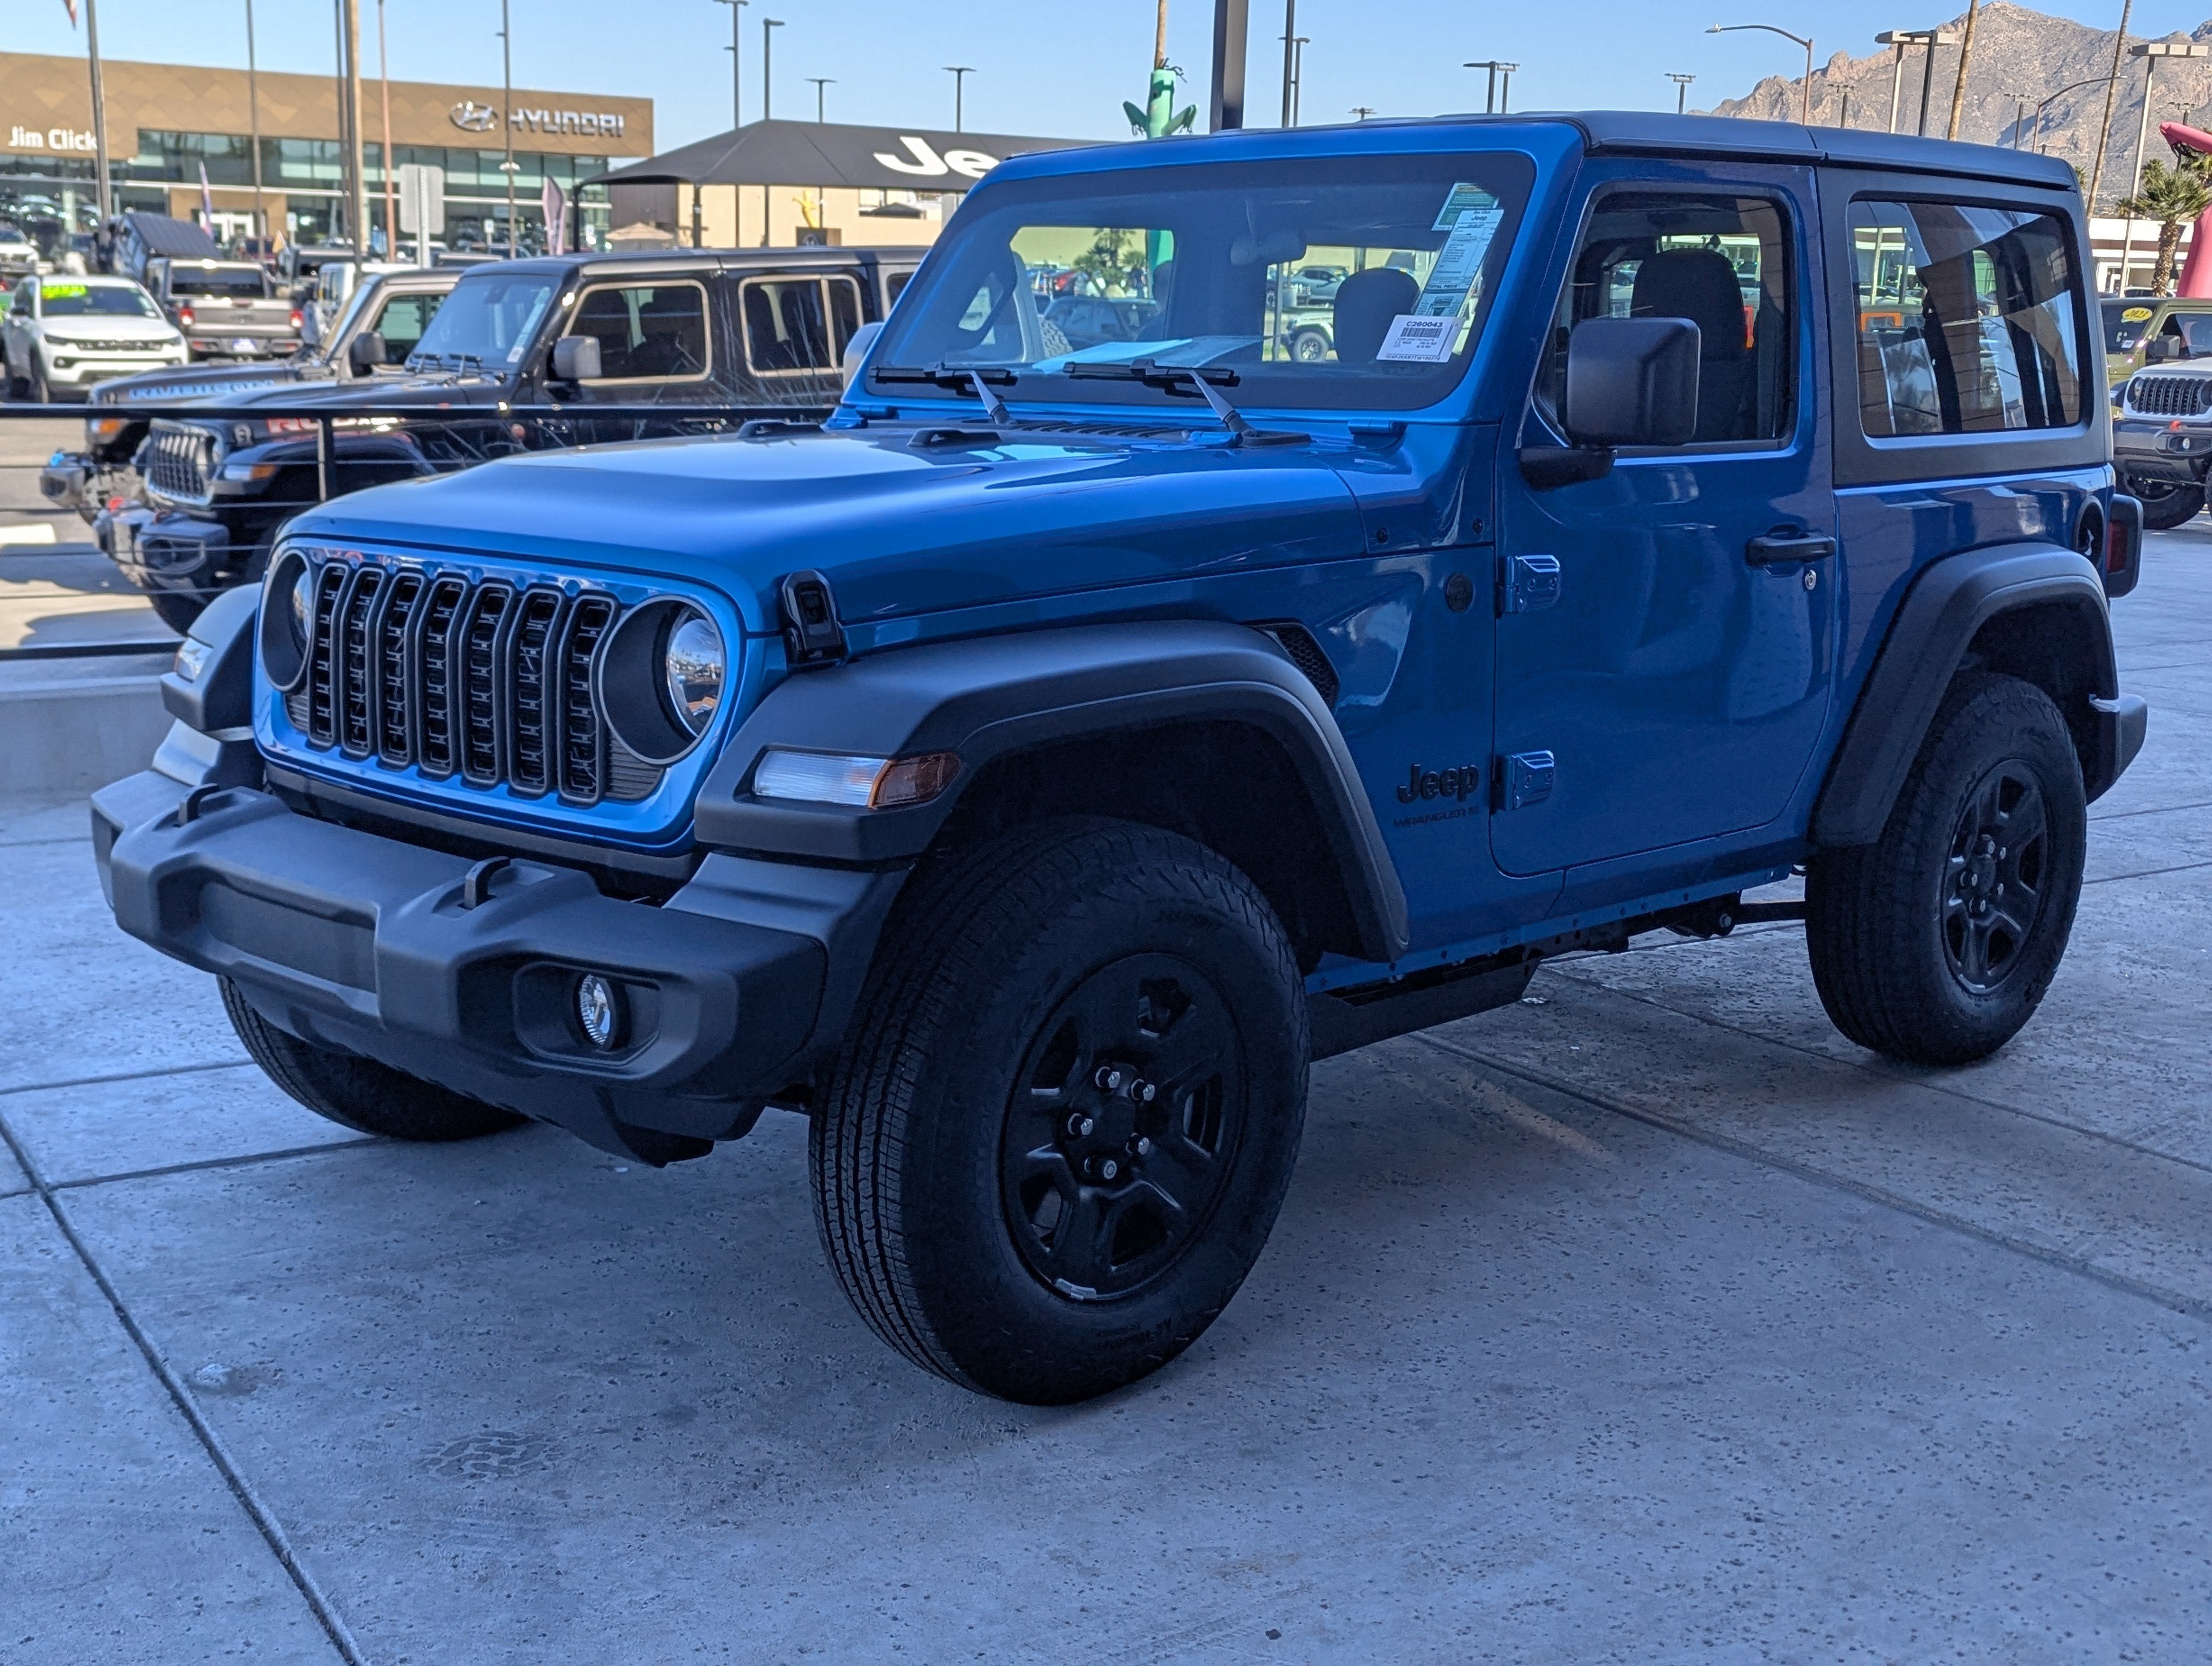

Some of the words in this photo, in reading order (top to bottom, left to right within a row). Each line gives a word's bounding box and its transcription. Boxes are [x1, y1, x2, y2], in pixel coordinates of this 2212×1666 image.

[510, 107, 625, 138] HYUNDAI
[8, 126, 44, 148] Jim
[48, 129, 98, 151] Click
[2125, 309, 2149, 318] 2023
[1396, 762, 1480, 804] Jeep
[1392, 808, 1467, 828] WRANGLER
